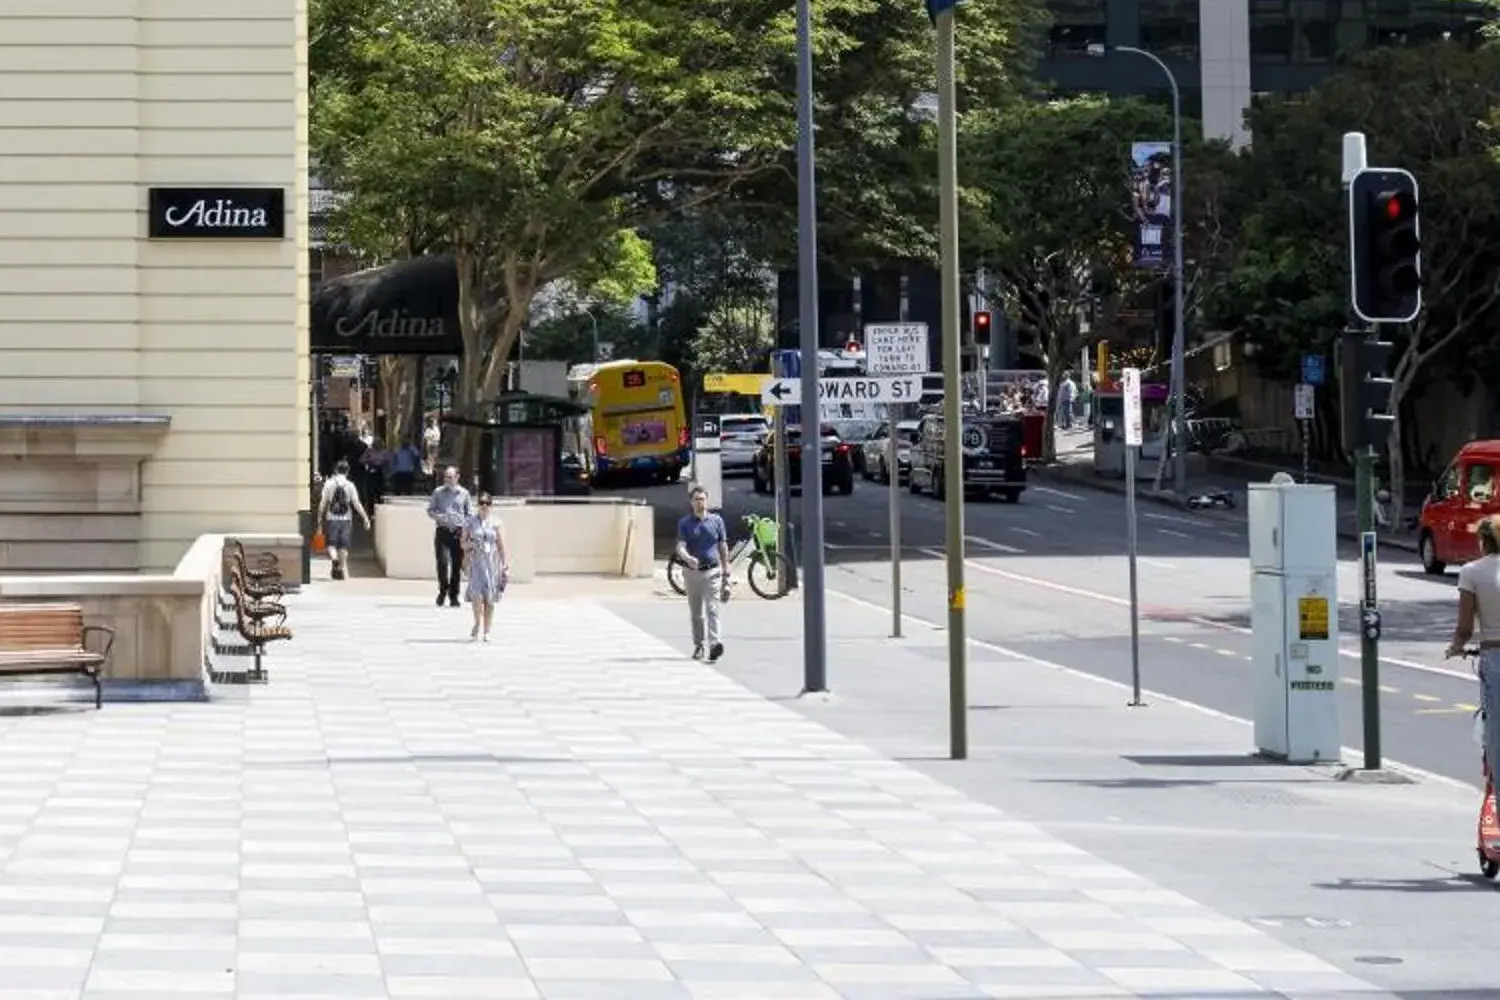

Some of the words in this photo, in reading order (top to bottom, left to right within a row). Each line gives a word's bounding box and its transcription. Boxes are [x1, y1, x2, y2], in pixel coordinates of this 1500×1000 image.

[165, 199, 267, 227] Adina
[335, 309, 446, 337] Adina
[891, 381, 912, 397] ST
